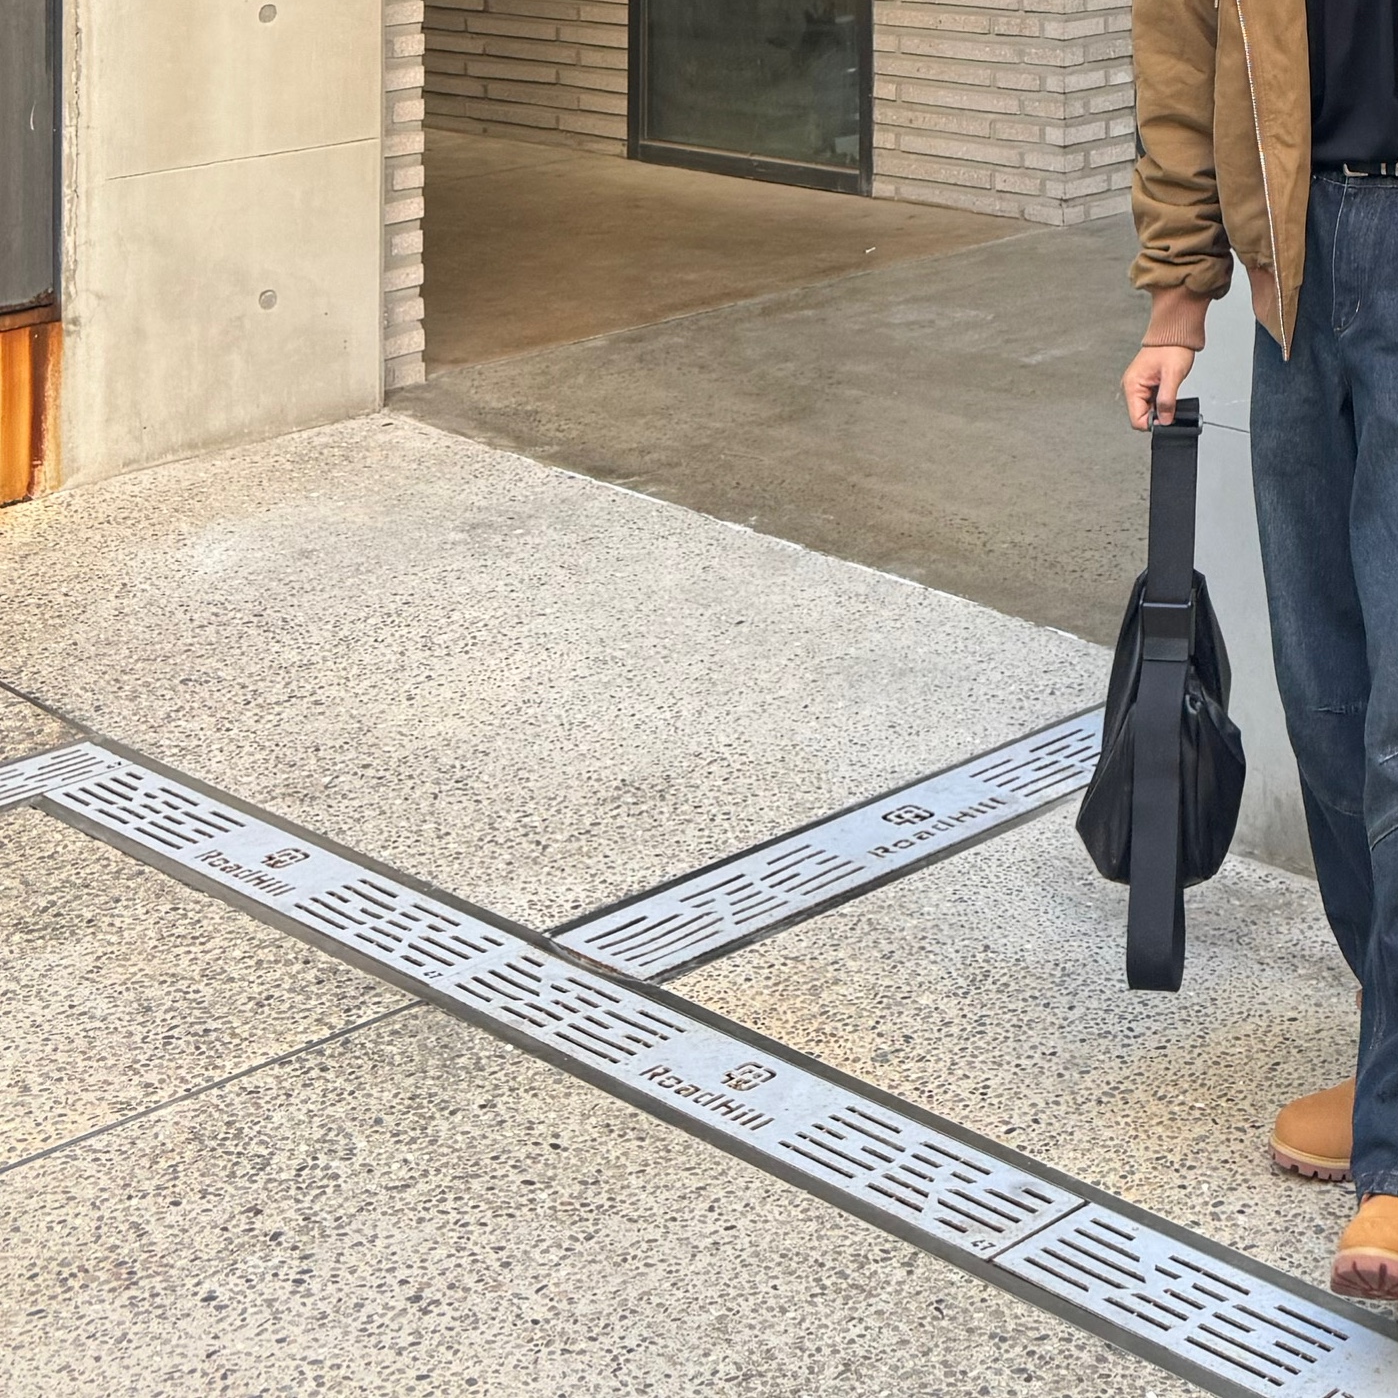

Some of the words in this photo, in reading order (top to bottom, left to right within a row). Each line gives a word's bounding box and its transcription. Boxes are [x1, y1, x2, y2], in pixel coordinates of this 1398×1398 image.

[866, 797, 1008, 859] RoadHill
[194, 848, 297, 897] RoadHill
[638, 1064, 776, 1131] RoadHill
